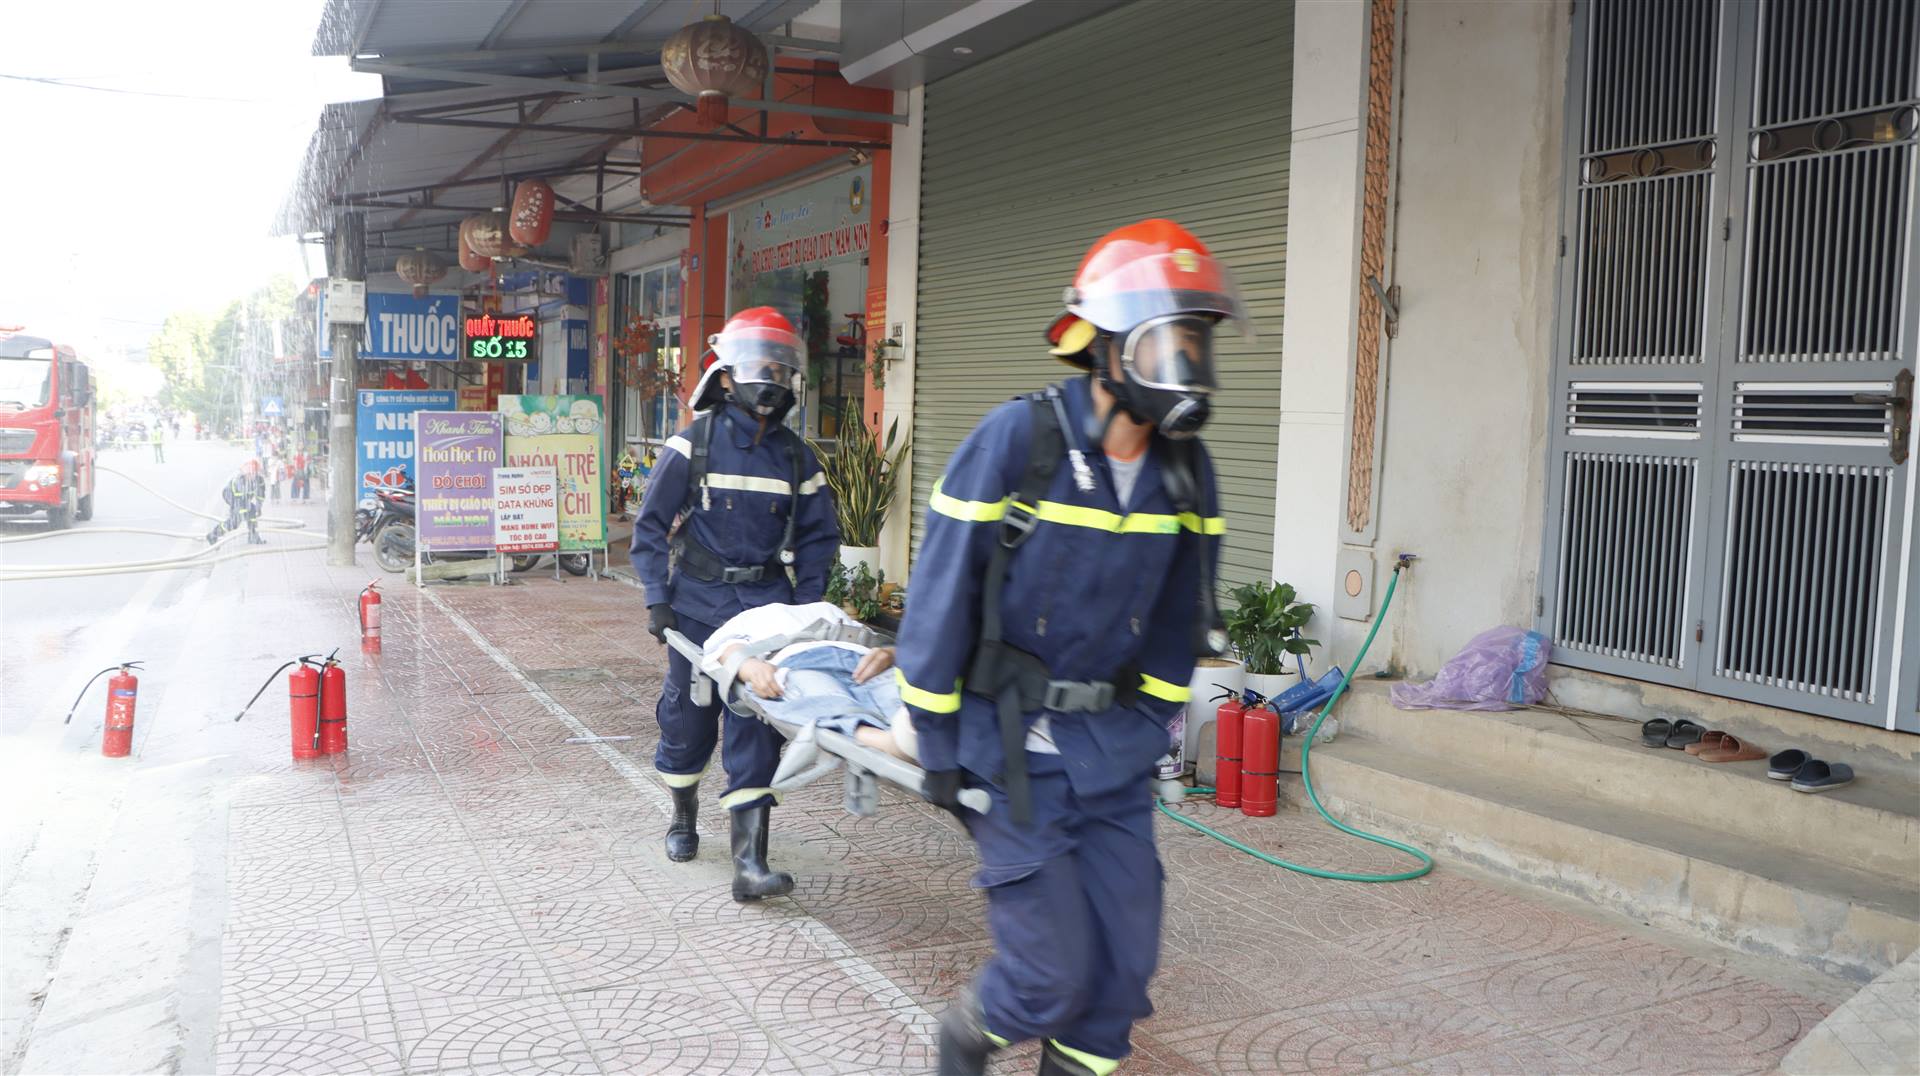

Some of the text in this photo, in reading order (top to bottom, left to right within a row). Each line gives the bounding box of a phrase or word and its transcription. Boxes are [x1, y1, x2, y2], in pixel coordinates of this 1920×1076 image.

[854, 223, 869, 250] NON
[380, 300, 456, 355] THUỐC
[466, 314, 534, 337] QUẦY THUỐC
[473, 335, 527, 358] SỐ 15
[375, 412, 415, 430] NH
[363, 441, 414, 459] THU
[423, 446, 497, 464] Hoa Học Trò
[509, 445, 596, 484] NHÓM TRẺ
[364, 464, 406, 487] SỐ
[455, 474, 486, 488] CHƠI
[499, 481, 551, 497] SIM SỐ ĐẸP
[481, 498, 496, 512] DỤ
[498, 500, 522, 510] DATA
[564, 493, 591, 515] CHI
